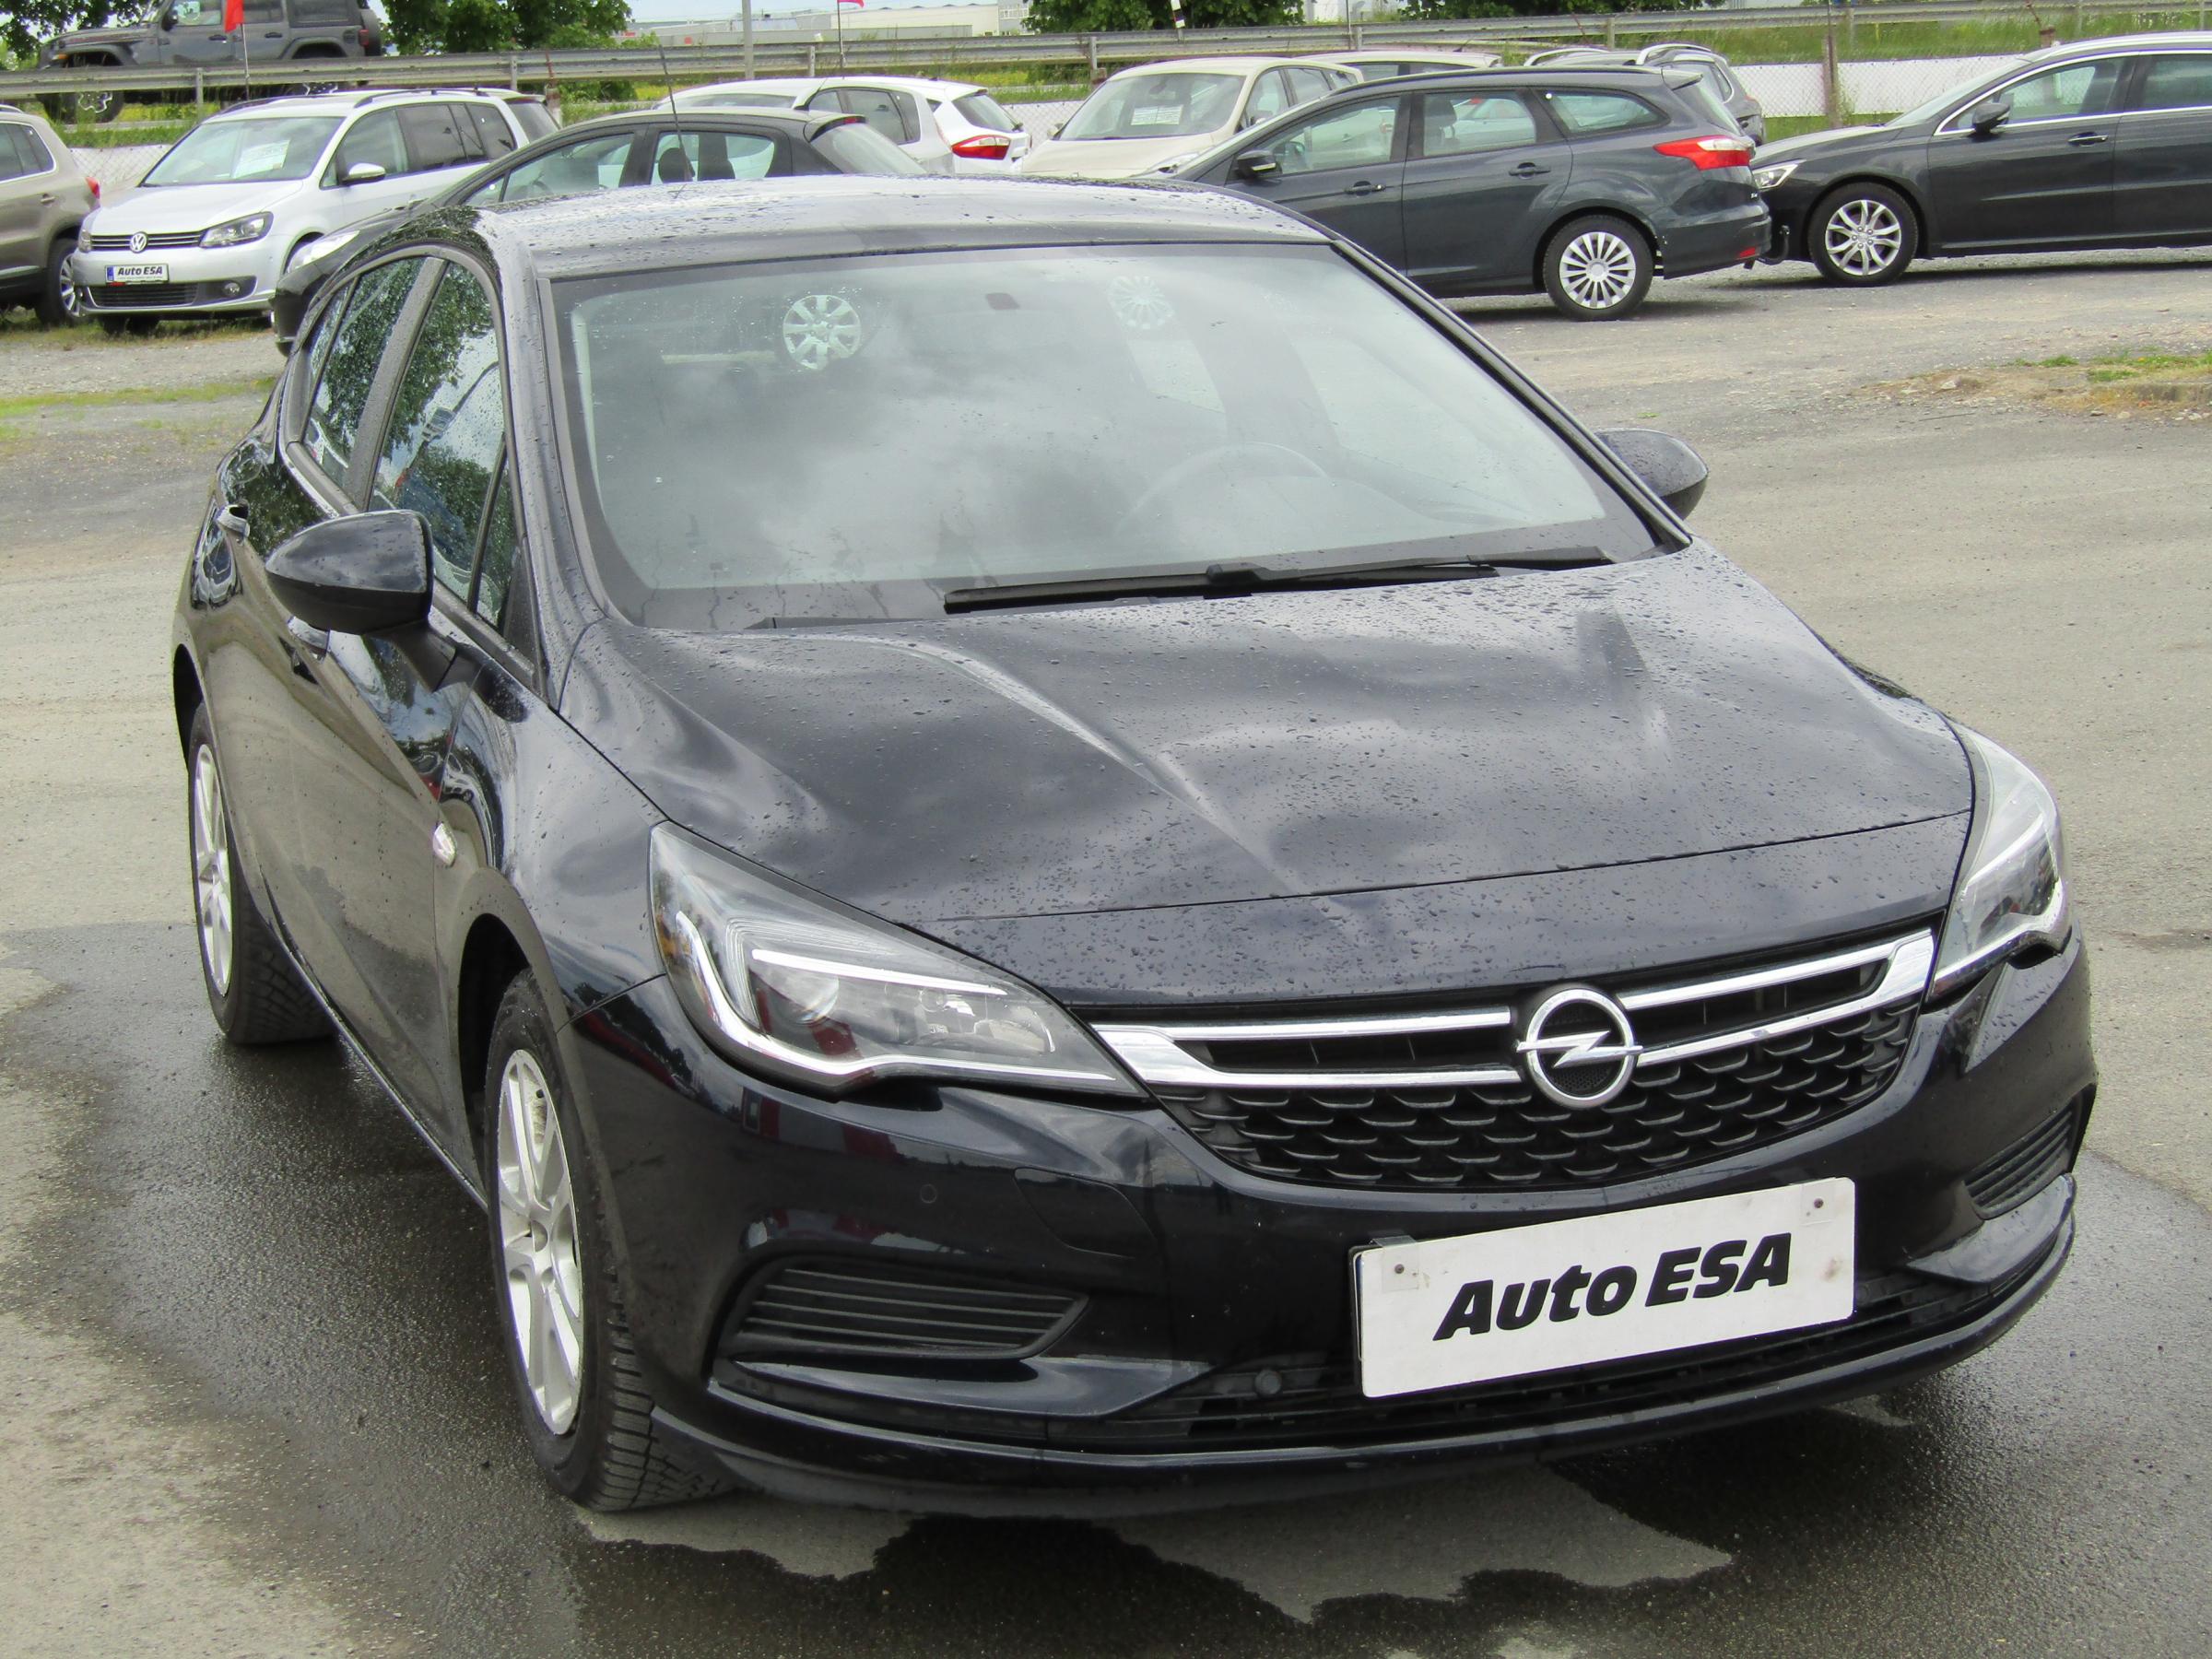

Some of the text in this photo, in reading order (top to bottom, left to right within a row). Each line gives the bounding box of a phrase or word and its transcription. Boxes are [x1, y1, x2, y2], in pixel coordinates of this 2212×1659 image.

[118, 266, 162, 276] Auto ESA
[1432, 1232, 1792, 1341] Auto ESA
